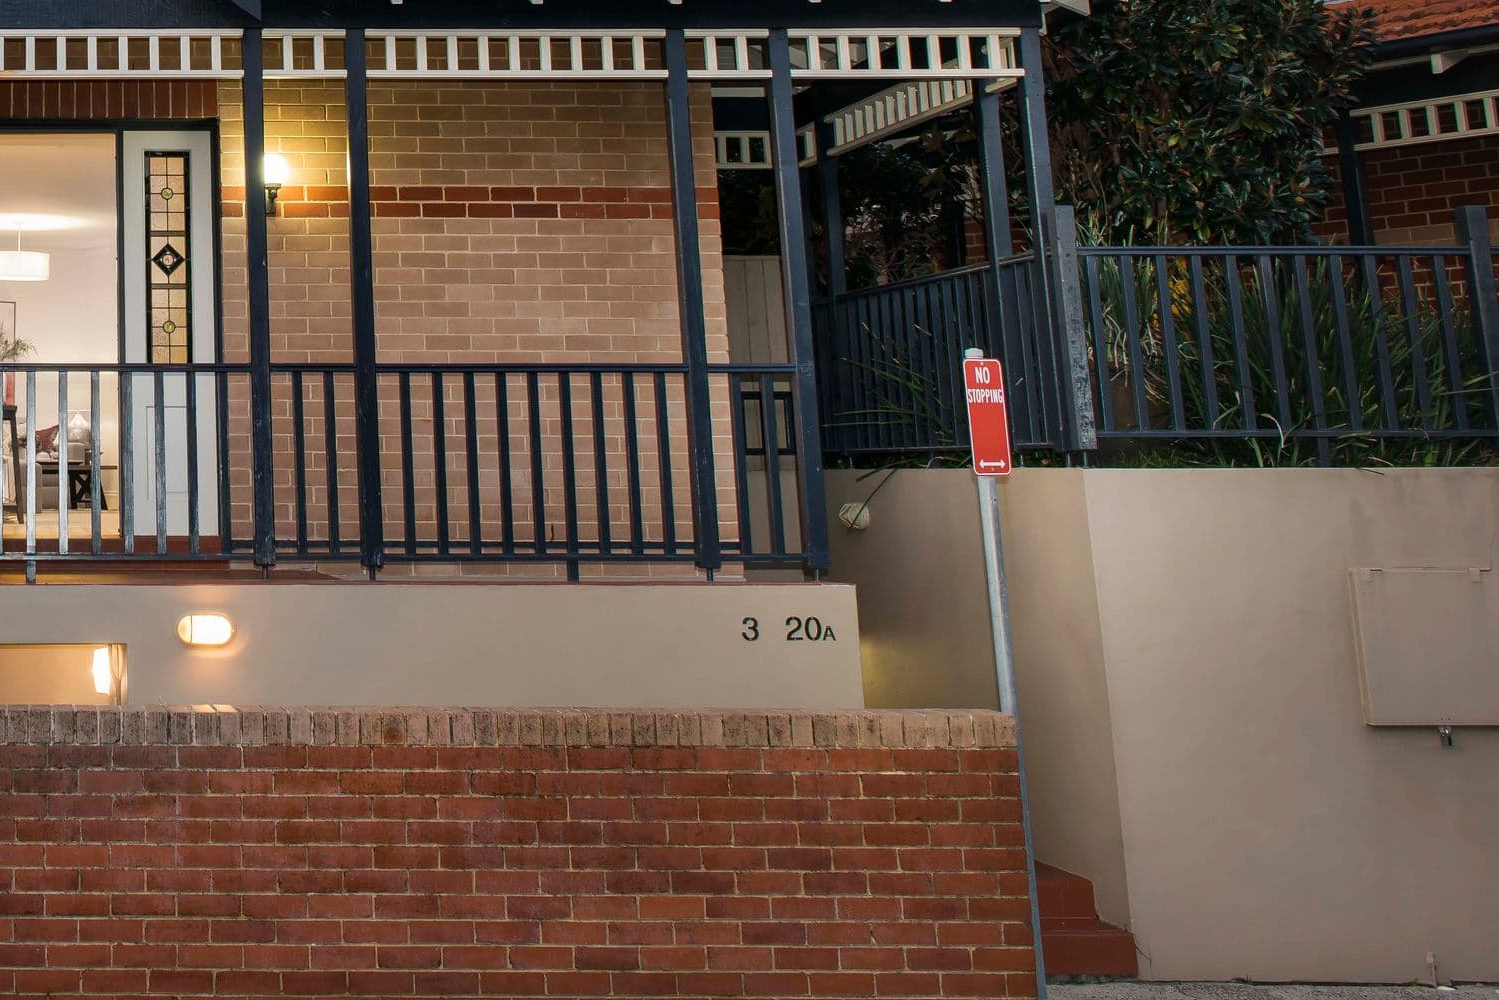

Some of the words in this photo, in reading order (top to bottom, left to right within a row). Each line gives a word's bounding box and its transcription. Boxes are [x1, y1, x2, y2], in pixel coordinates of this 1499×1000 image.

[974, 366, 991, 384] NO
[967, 388, 1003, 404] STOPPING
[742, 616, 759, 642] 3
[785, 616, 837, 642] 20A
